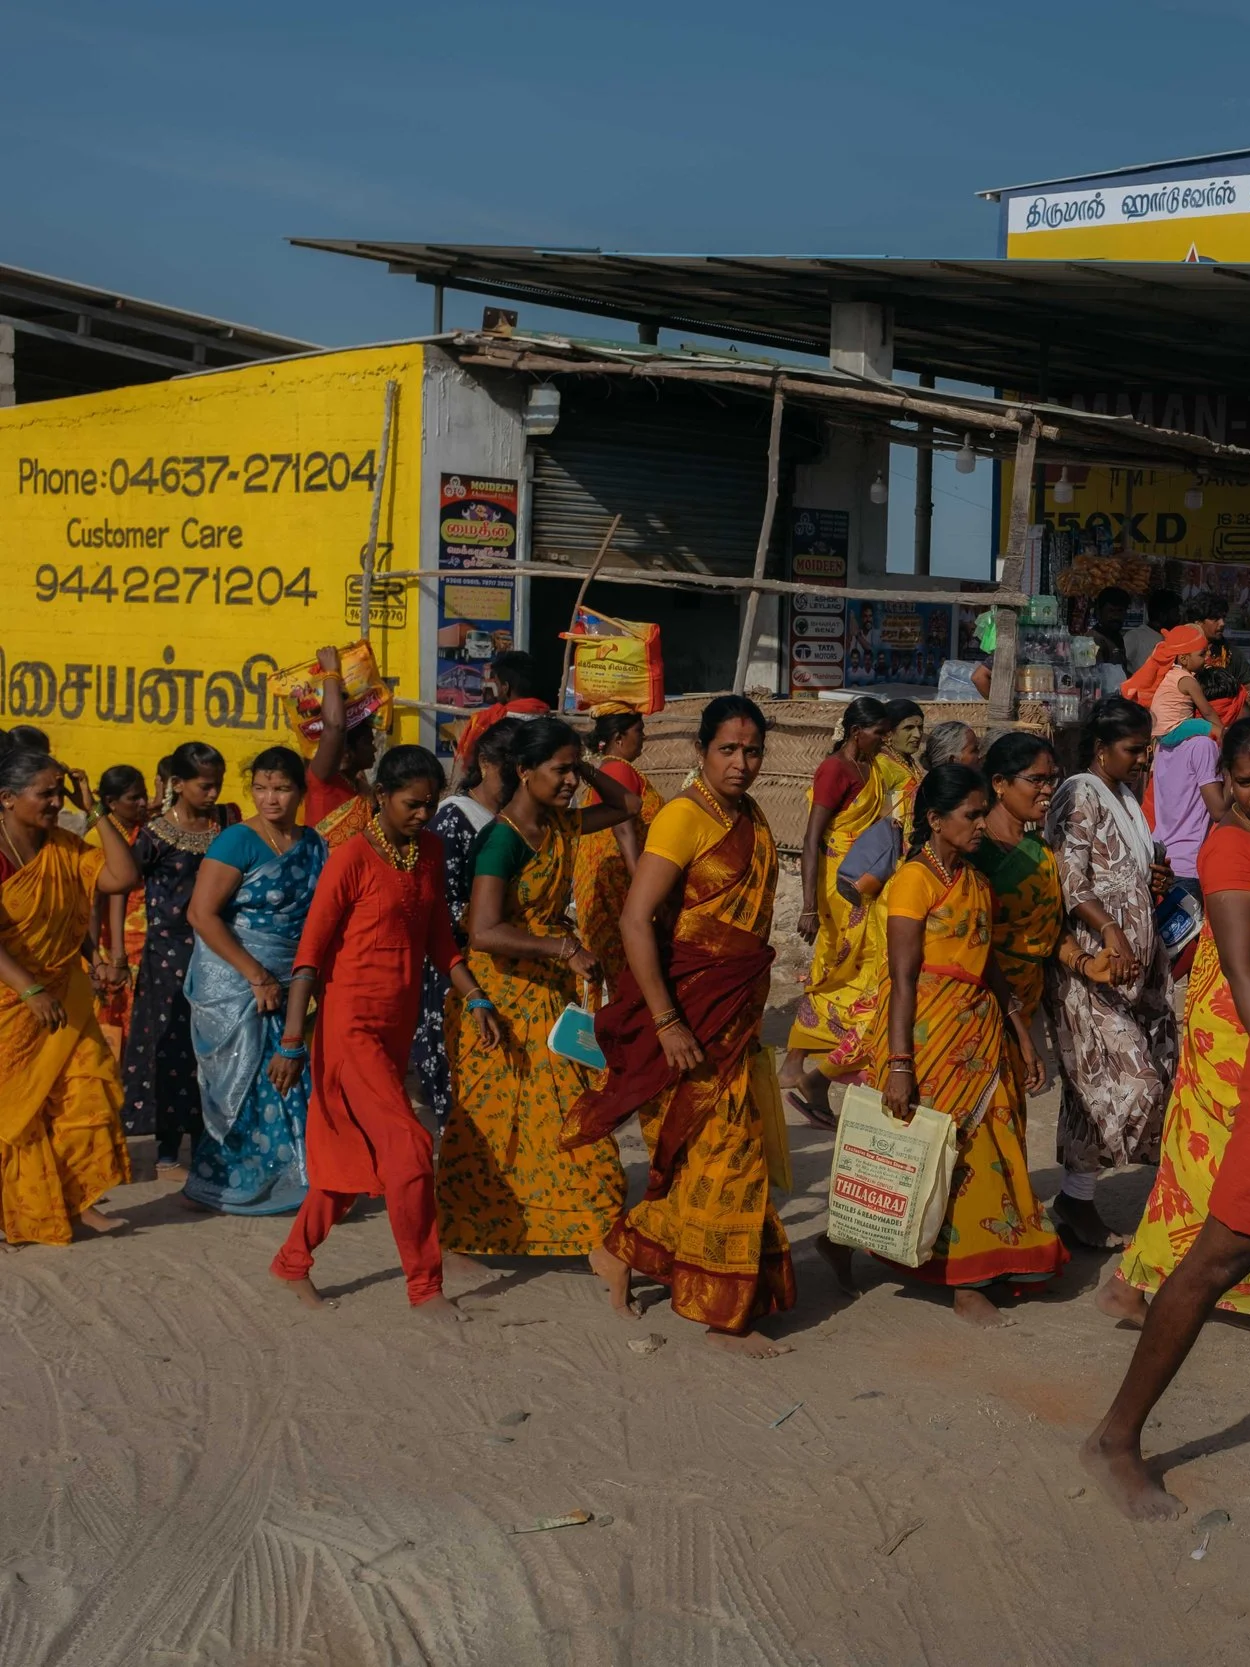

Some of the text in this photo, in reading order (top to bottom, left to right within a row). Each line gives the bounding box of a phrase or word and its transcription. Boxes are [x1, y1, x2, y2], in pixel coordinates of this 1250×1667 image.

[1026, 180, 1237, 231] திருமால் ஹார்டுவேர்ஸ்
[66, 516, 244, 549] Customer Care
[35, 563, 318, 607] 9442271204
[818, 644, 835, 652] TATA
[836, 1178, 906, 1213] THILAGARAJ
[832, 1200, 856, 1214] TEXTILES
[862, 1211, 903, 1227] READYMADES
